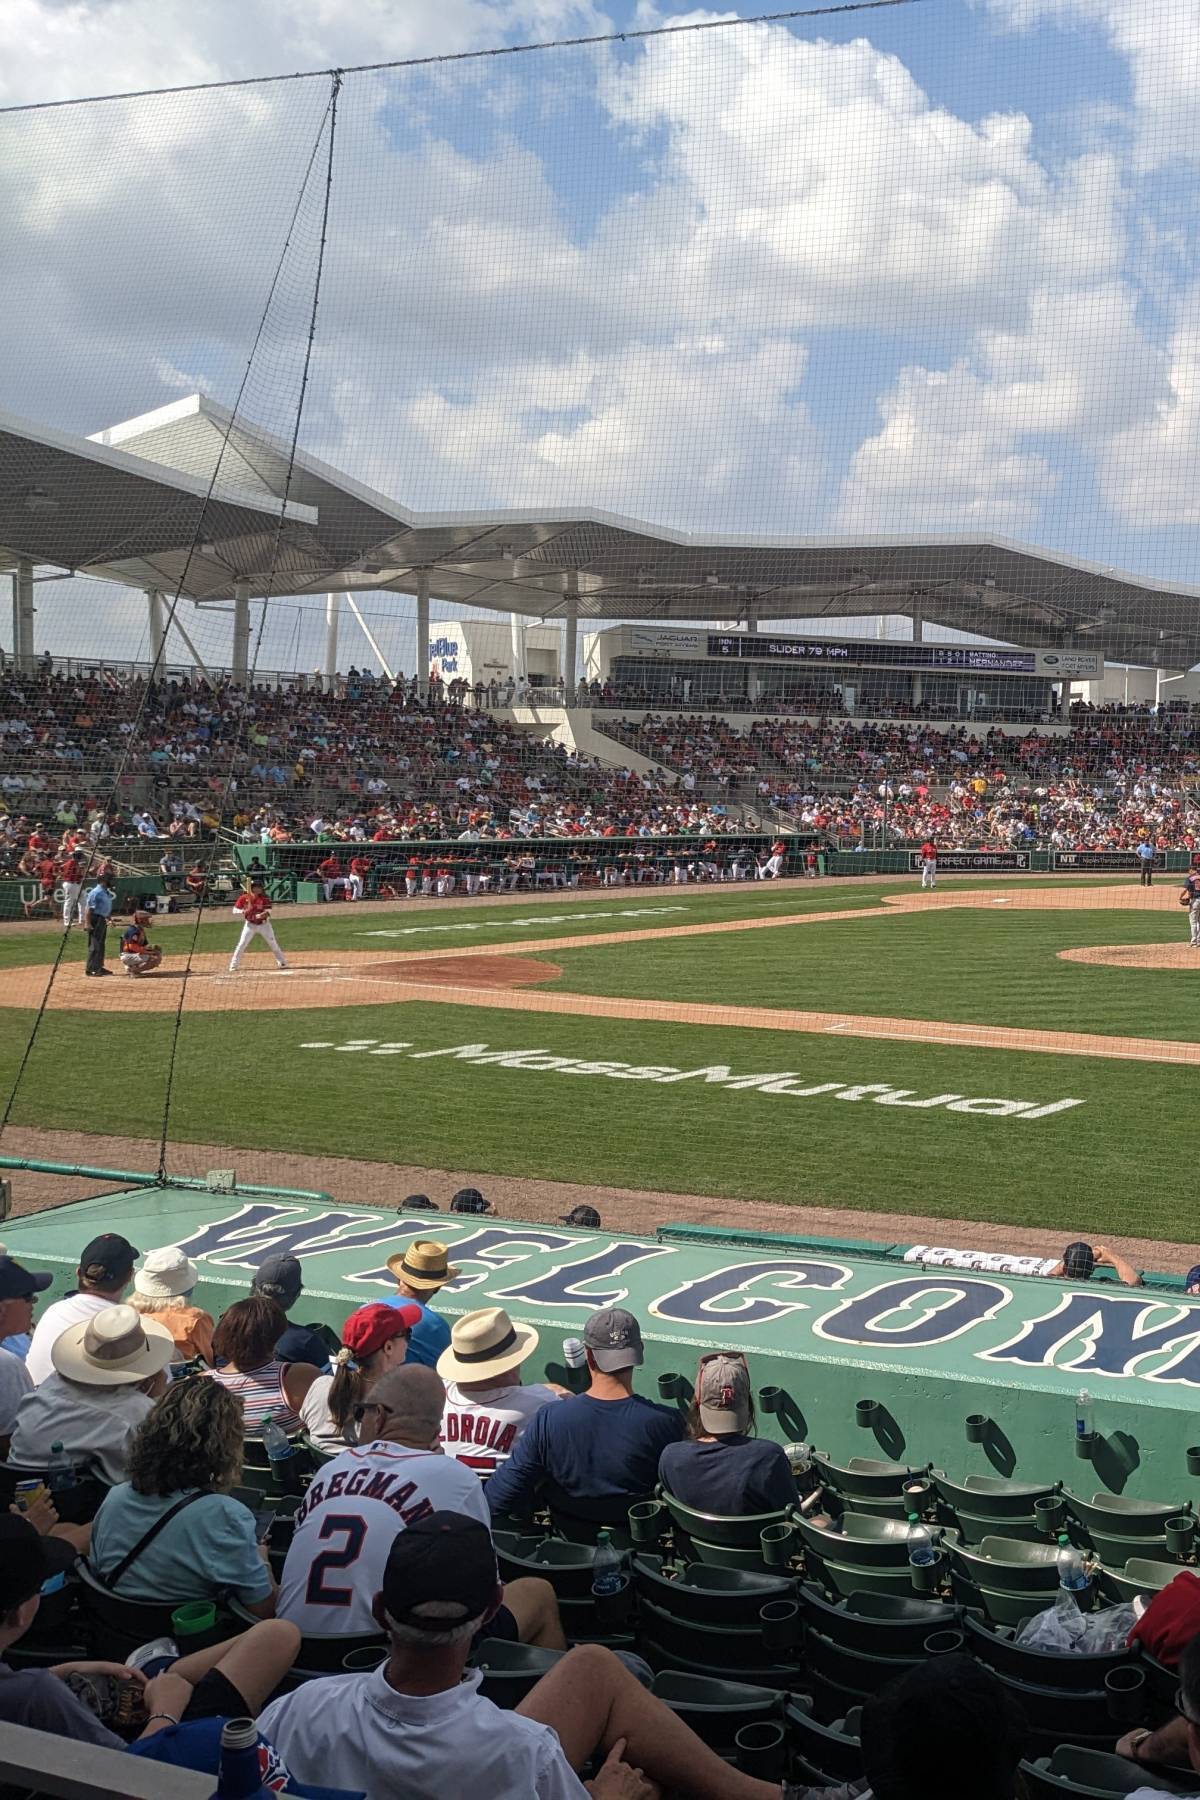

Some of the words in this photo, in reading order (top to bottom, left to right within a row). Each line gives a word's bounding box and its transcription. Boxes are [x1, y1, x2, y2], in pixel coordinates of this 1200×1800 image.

[656, 635, 698, 643] JAGUAR
[722, 645, 729, 654] 5
[769, 644, 805, 655] SLIDER
[808, 646, 823, 656] 79
[826, 648, 848, 657] MPH
[442, 657, 458, 673] Park
[936, 856, 972, 866] ERFECT
[407, 1044, 1087, 1118] MassMutual
[438, 1413, 518, 1453] DROIA
[298, 1468, 434, 1526] BREGMAN
[305, 1514, 368, 1606] 2
